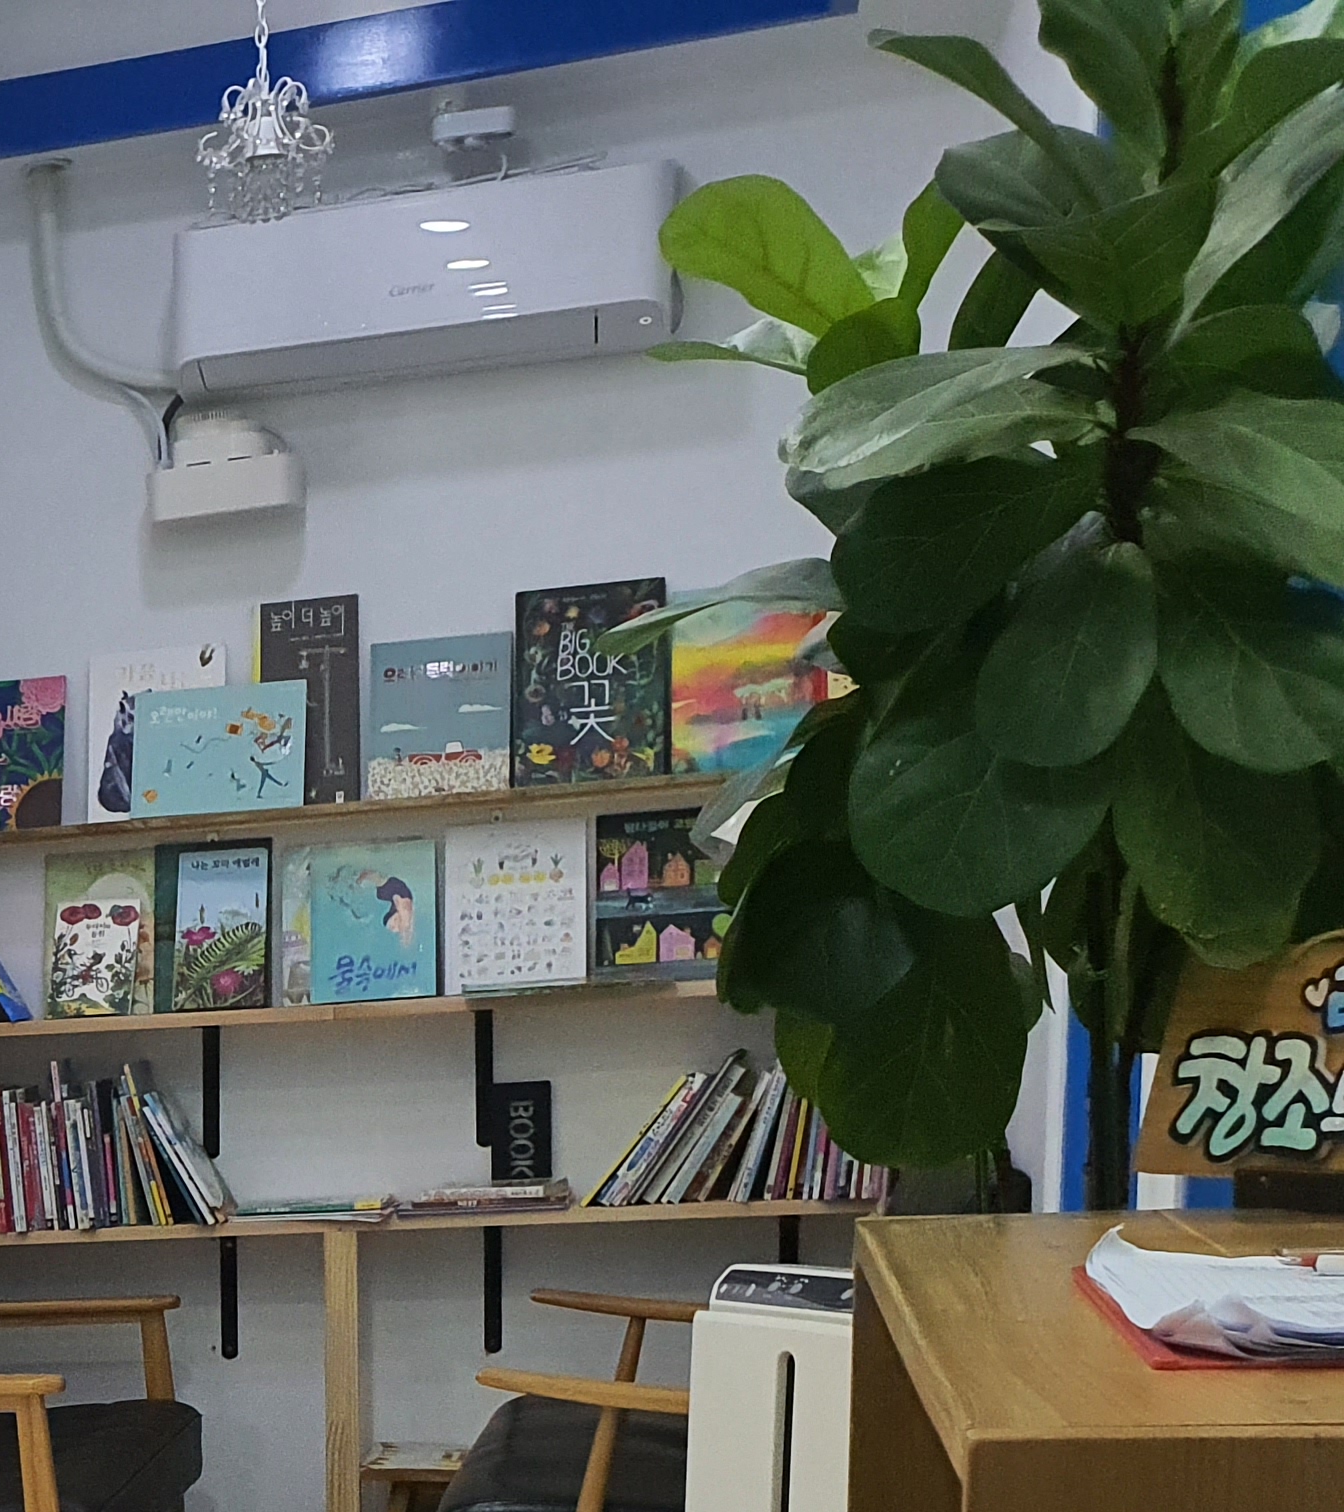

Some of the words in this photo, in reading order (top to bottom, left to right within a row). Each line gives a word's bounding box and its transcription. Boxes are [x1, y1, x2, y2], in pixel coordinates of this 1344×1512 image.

[389, 284, 435, 298] Carrier
[270, 601, 295, 632] 높이
[301, 607, 313, 627] 더
[319, 604, 345, 636] 높이
[559, 629, 590, 656] BIG
[557, 652, 627, 681] BOOK
[567, 680, 616, 746] 꽃
[191, 860, 209, 871] 나는
[329, 954, 417, 995] 물속에서
[509, 1101, 535, 1178] BOOK
